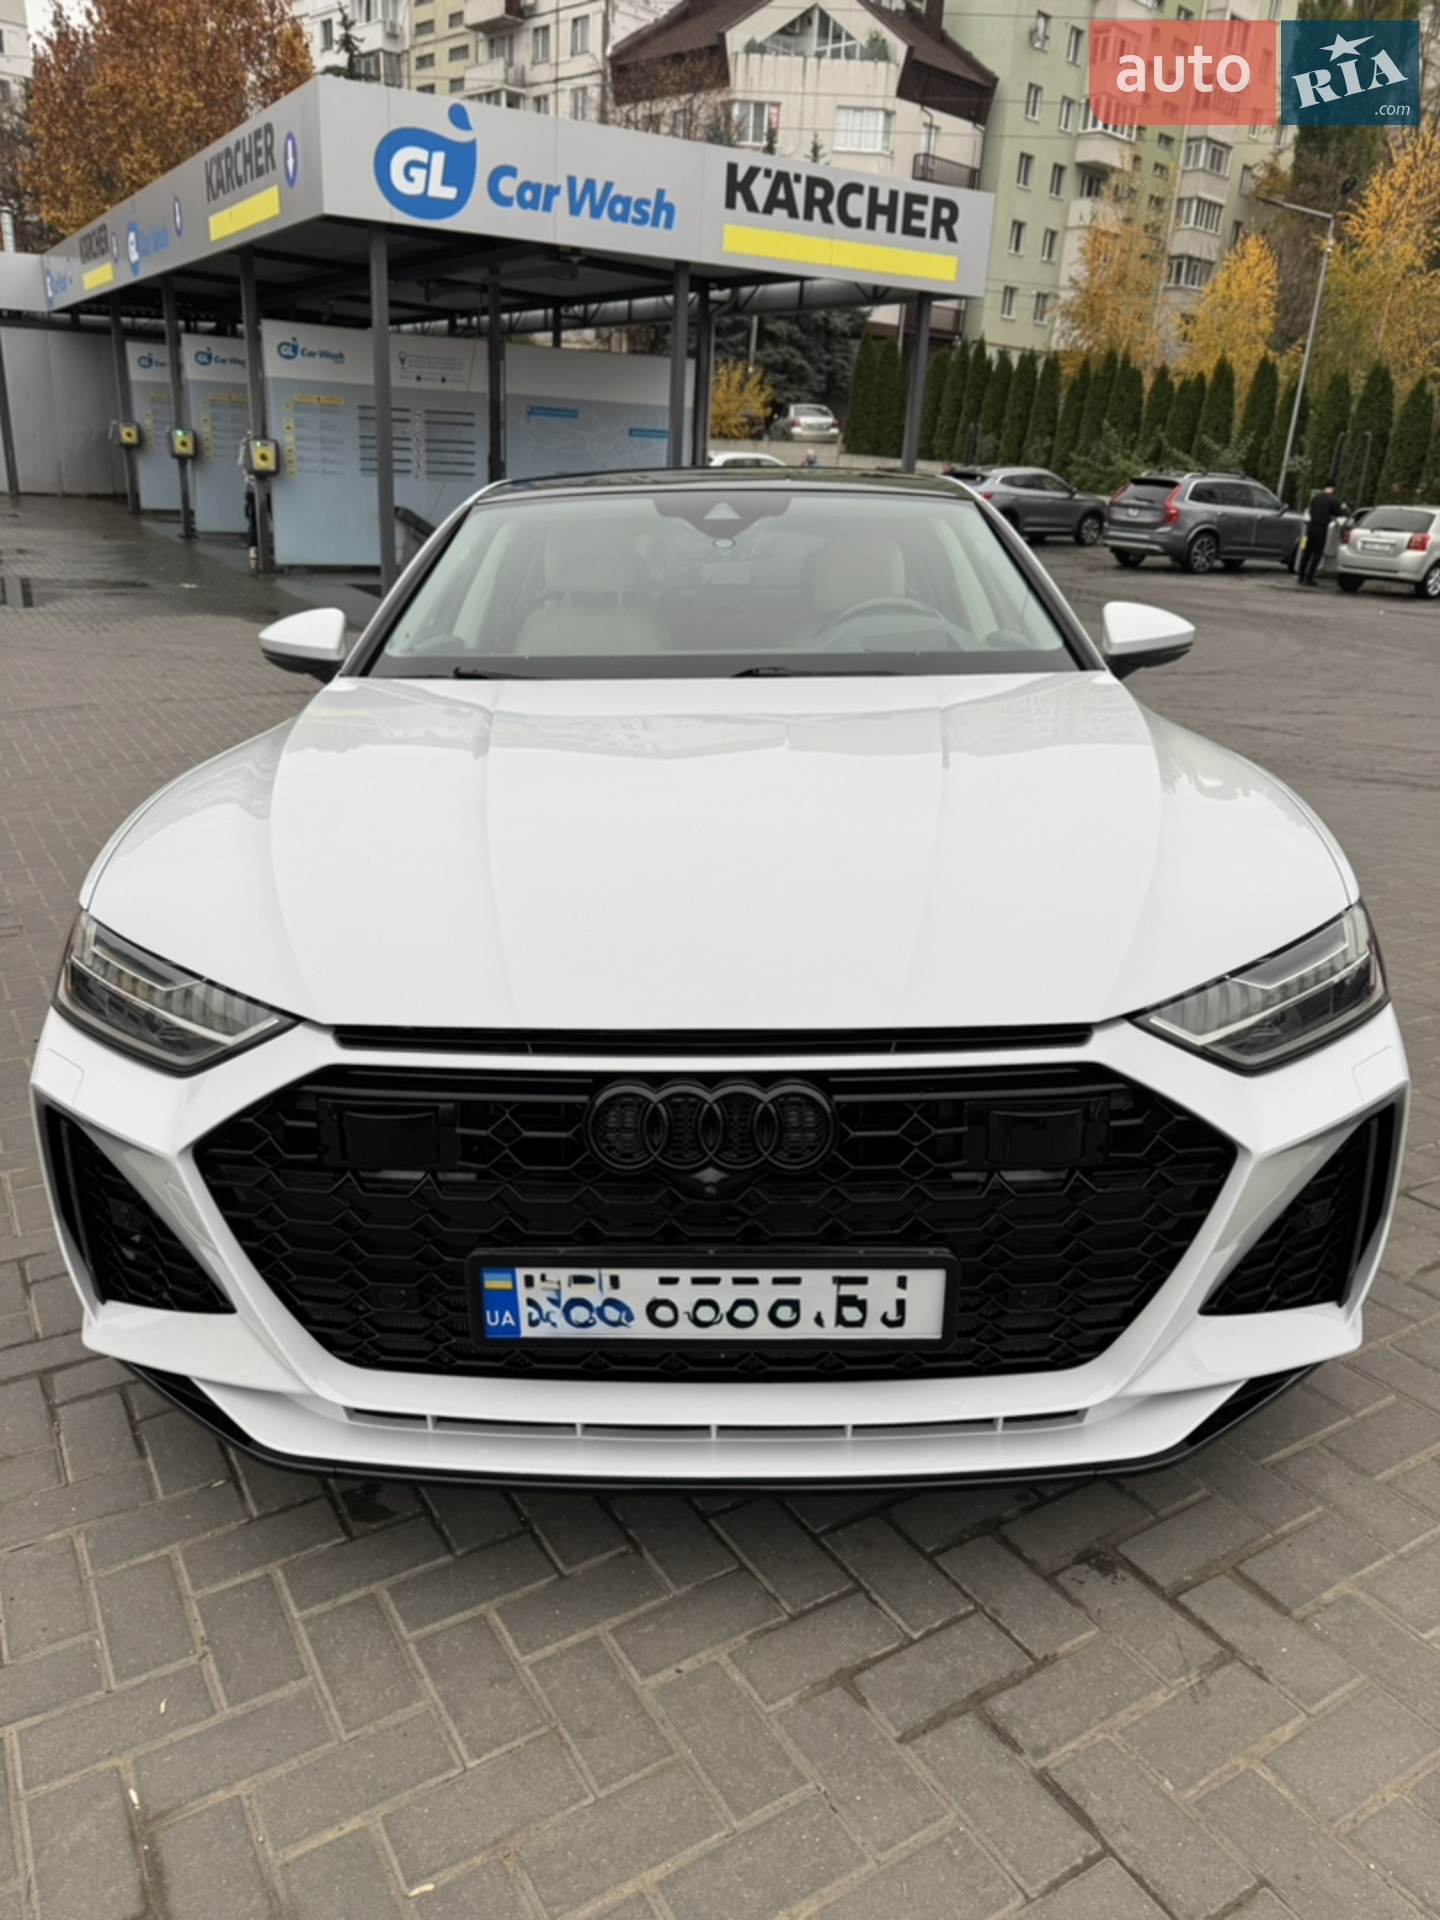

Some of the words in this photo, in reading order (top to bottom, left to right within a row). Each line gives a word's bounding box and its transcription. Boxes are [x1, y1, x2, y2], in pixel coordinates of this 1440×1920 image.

[204, 121, 276, 203] KÄRCHER
[390, 146, 458, 200] GL
[725, 161, 959, 243] KÄRCHER
[486, 1310, 516, 1327] UA
